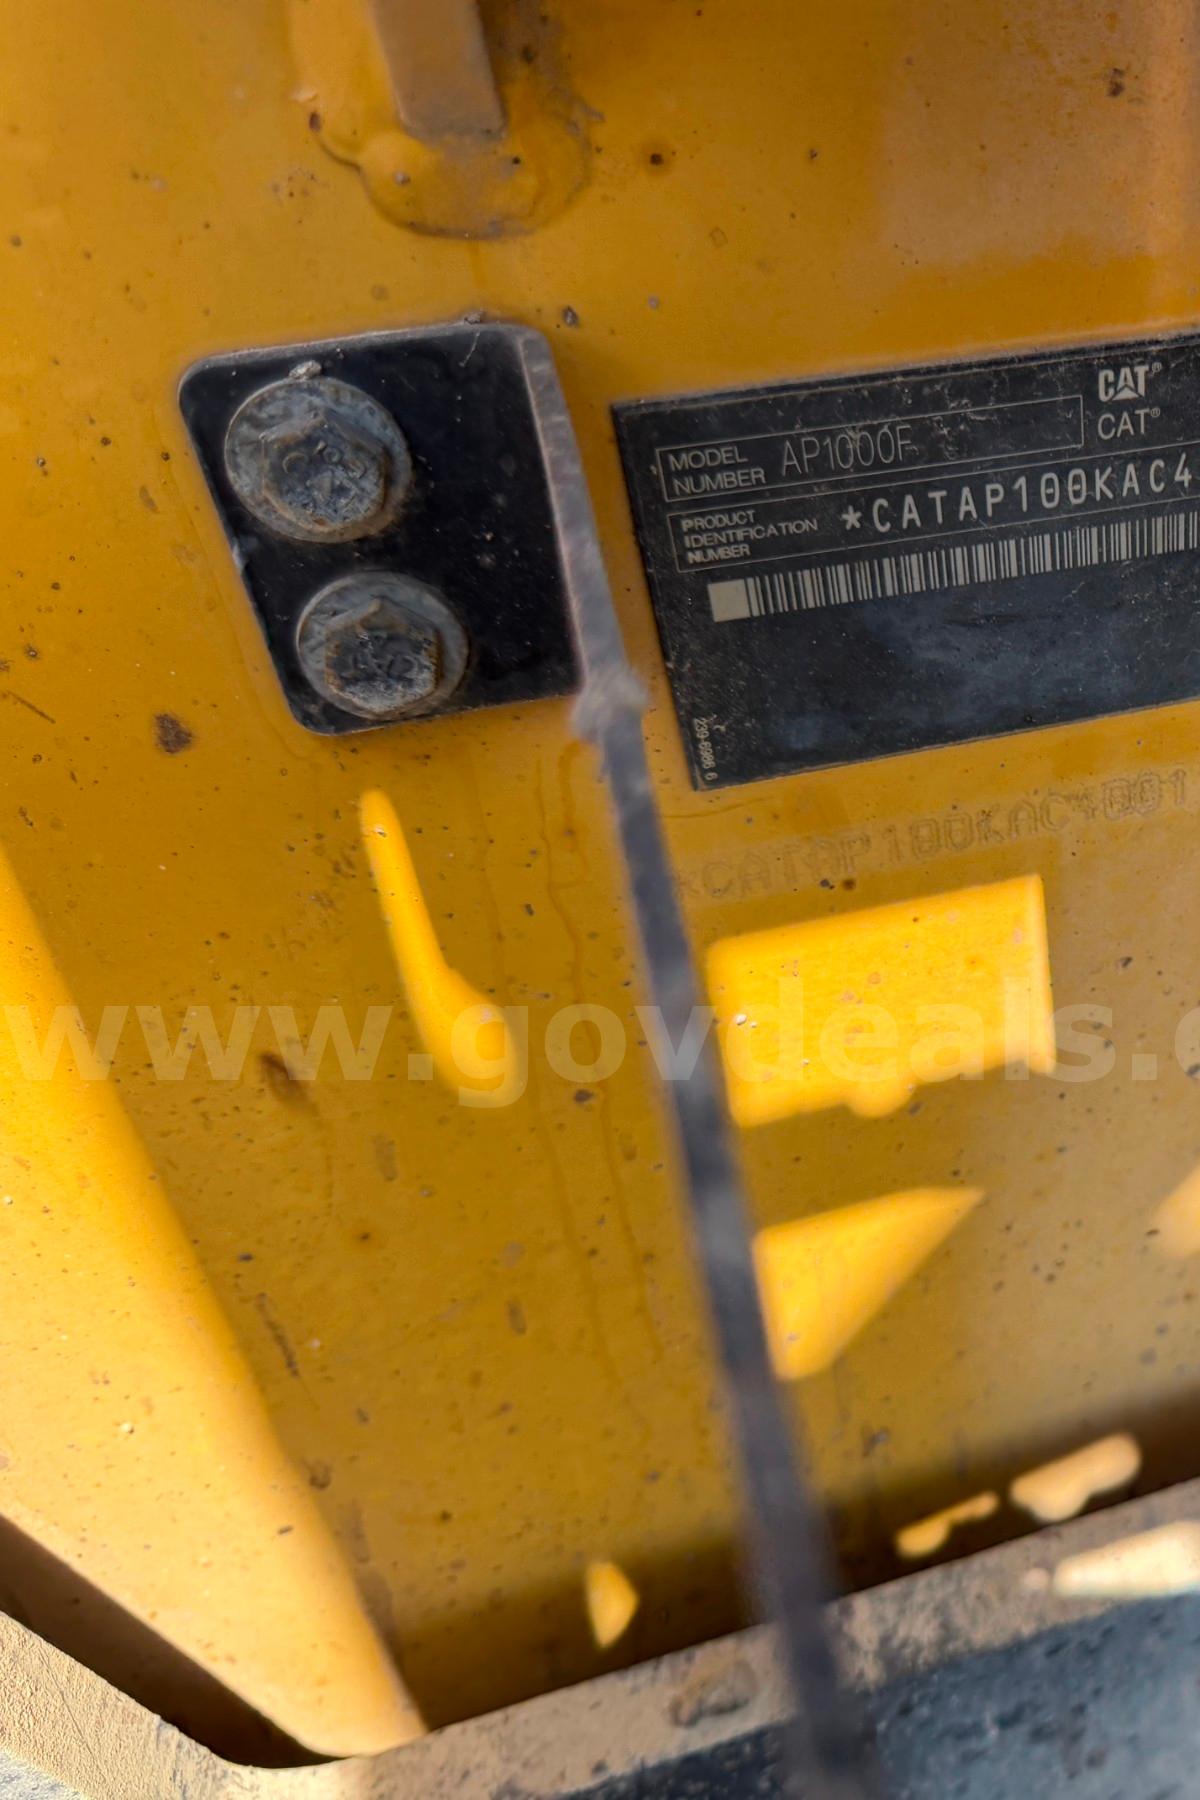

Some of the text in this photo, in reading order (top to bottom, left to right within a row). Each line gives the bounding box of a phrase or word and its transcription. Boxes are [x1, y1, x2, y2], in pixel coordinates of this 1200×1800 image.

[669, 446, 748, 472] MODEL
[781, 424, 912, 477] AP1000F
[673, 467, 767, 496] NUMBER
[681, 510, 756, 533] PRODUCT
[684, 518, 819, 548] IDENTIFICATION
[687, 544, 751, 565] NUMBER
